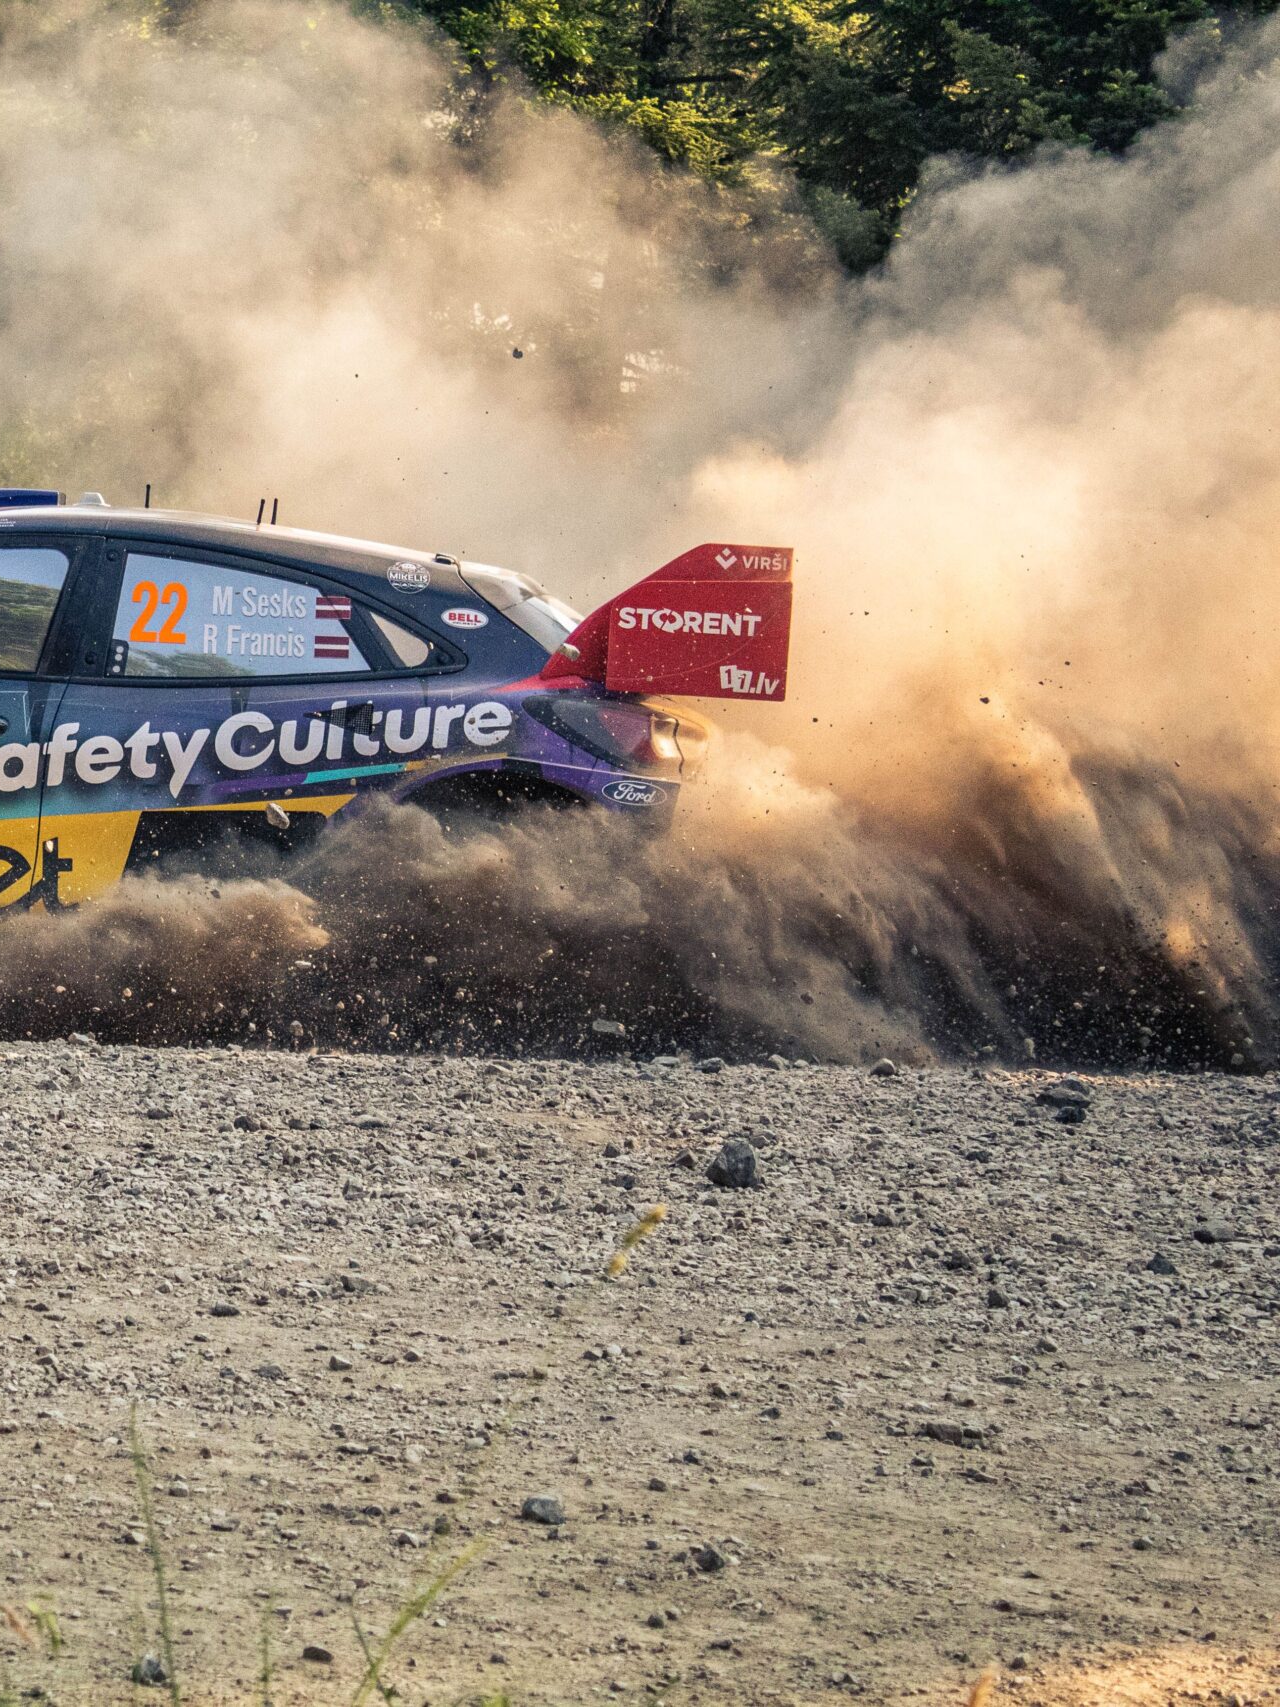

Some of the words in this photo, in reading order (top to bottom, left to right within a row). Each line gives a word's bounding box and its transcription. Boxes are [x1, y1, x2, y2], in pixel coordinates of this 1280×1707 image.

[742, 553, 788, 571] VIRŠI
[129, 580, 189, 645] 22
[212, 585, 232, 616] M
[242, 587, 307, 619] Sesks
[448, 612, 481, 624] BELL
[619, 606, 761, 637] STORENT
[203, 623, 217, 655] R
[227, 625, 305, 658] Francis
[613, 782, 657, 802] Ford
